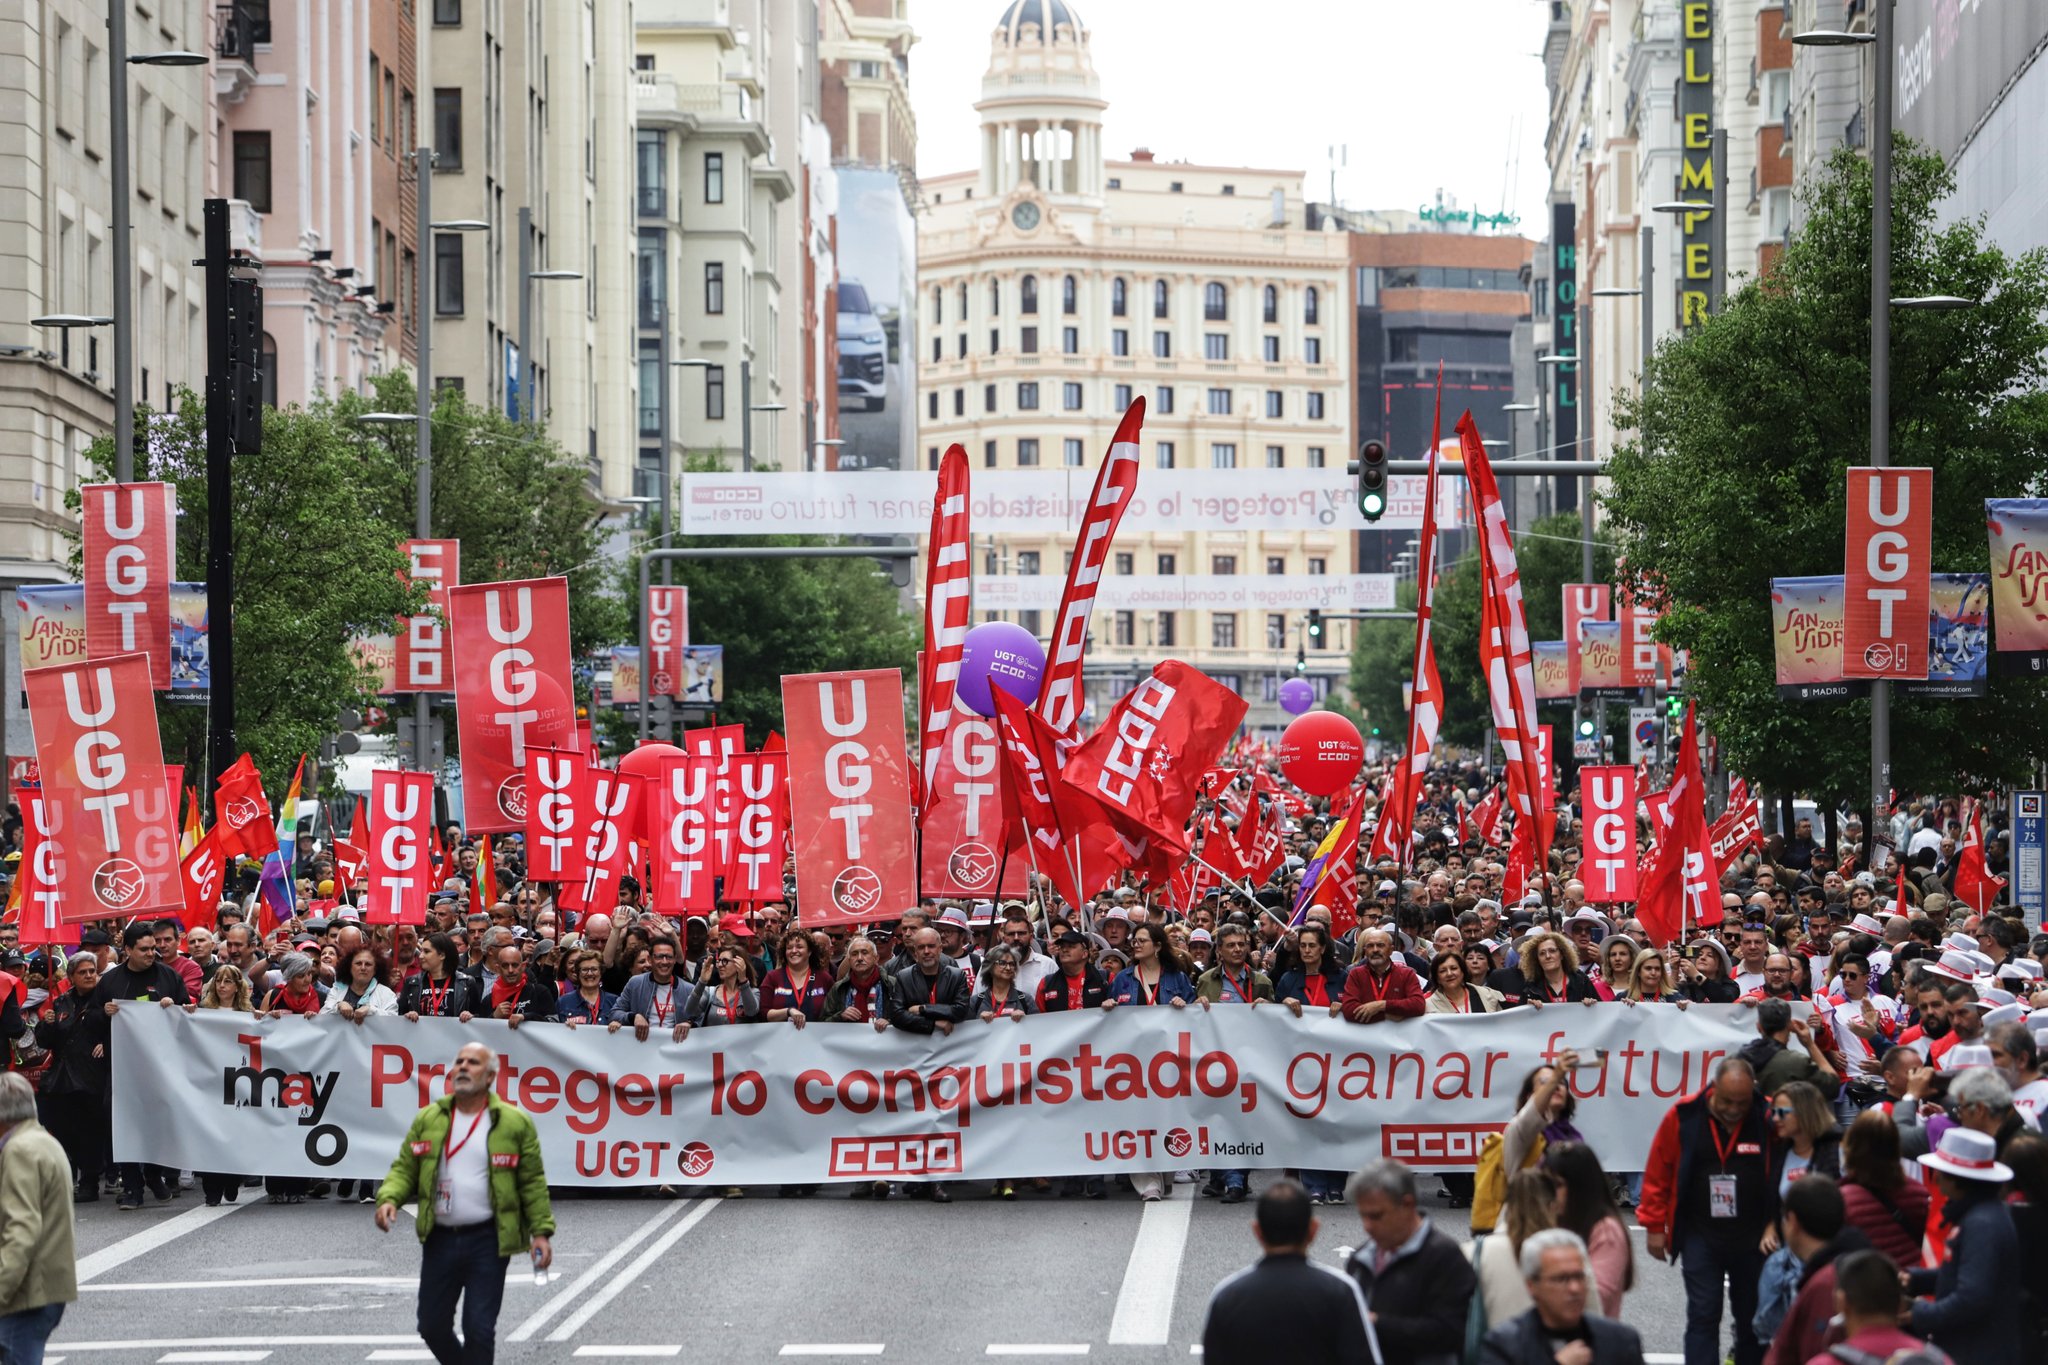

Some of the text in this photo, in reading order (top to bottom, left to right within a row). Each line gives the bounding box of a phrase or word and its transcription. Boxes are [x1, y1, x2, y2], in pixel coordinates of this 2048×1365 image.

[1899, 25, 1932, 119] Reserva
[1558, 245, 1575, 407] HOTEL
[104, 490, 147, 652] UGT
[1867, 476, 1910, 638] UGT
[25, 616, 64, 641] SAN
[651, 591, 672, 670] UGT
[994, 649, 1017, 662] UGT
[1585, 640, 1610, 655] SAN
[1779, 608, 1819, 634] SAN
[485, 587, 538, 768] UGT
[990, 661, 1026, 680] CCOO
[1813, 687, 1848, 696] MADRID
[1908, 685, 1972, 695] sanisidromadrid.com
[62, 666, 129, 853] UGT
[818, 679, 873, 861] UGT
[952, 694, 996, 837] GT
[1097, 676, 1177, 807] CCOO
[1318, 741, 1339, 750] UGT
[1318, 752, 1350, 761] CCOO
[381, 783, 419, 914] UGT
[537, 756, 575, 872] UGT
[670, 767, 706, 899] UGT
[738, 763, 774, 891] UGT
[1592, 776, 1626, 893] UGT
[2024, 818, 2036, 829] 44
[2024, 831, 2036, 842] 75
[371, 1043, 686, 1135] Prteger
[711, 1052, 768, 1117] lo
[794, 1031, 1257, 1128] conquistado,
[1286, 1051, 1509, 1119] ganar
[575, 1141, 670, 1178] UGT
[835, 1137, 959, 1173] CCOO
[1085, 1129, 1265, 1161] UGT Madrid
